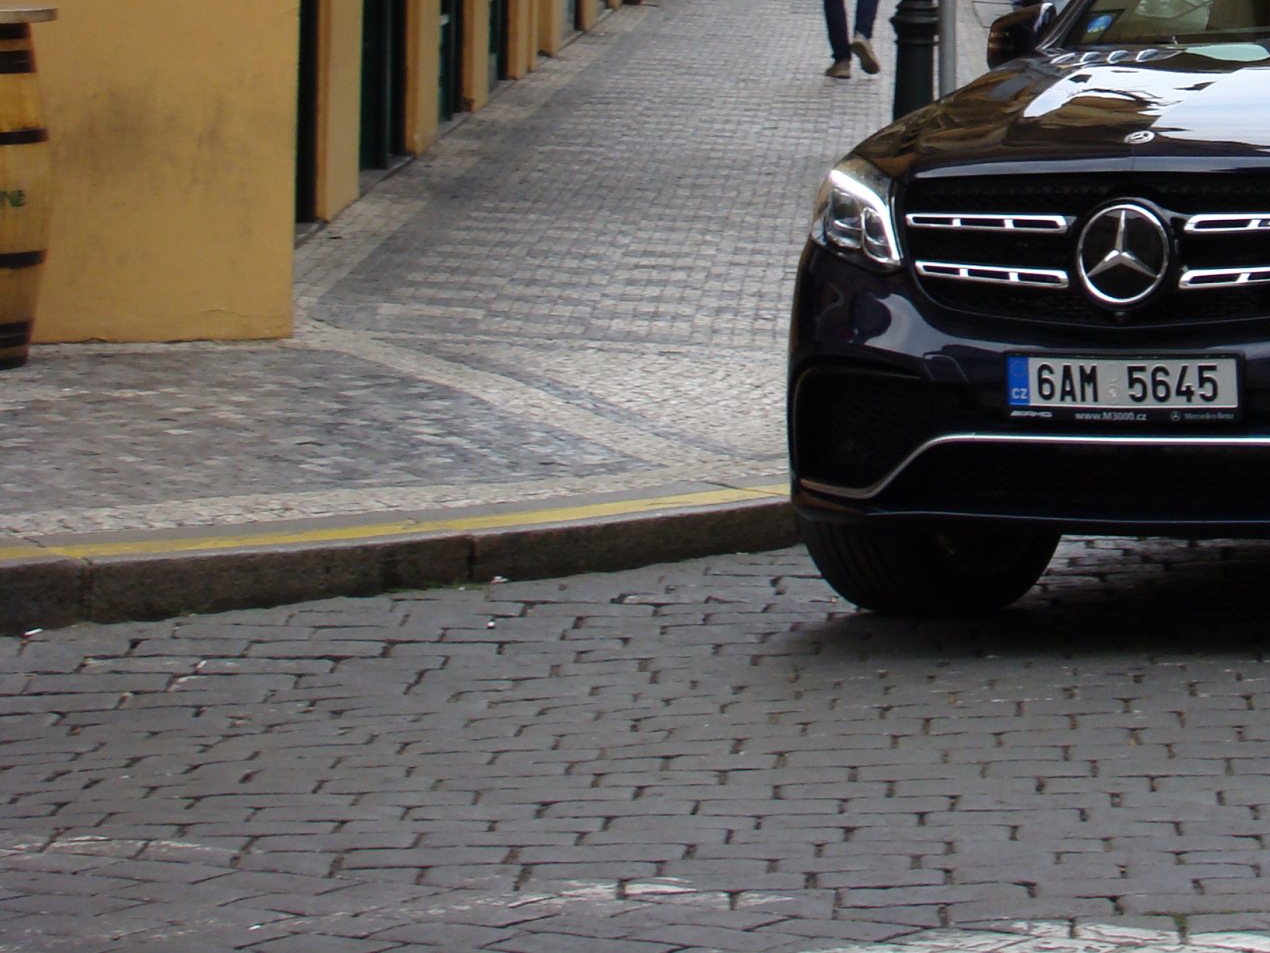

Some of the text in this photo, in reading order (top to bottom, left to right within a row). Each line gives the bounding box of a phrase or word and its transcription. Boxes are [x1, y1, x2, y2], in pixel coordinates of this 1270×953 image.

[1036, 364, 1219, 403] 6AM 5645
[1011, 387, 1028, 400] CZ
[1075, 411, 1147, 421] www.M3000.cz
[1184, 412, 1235, 420] Mercedes-Benz
